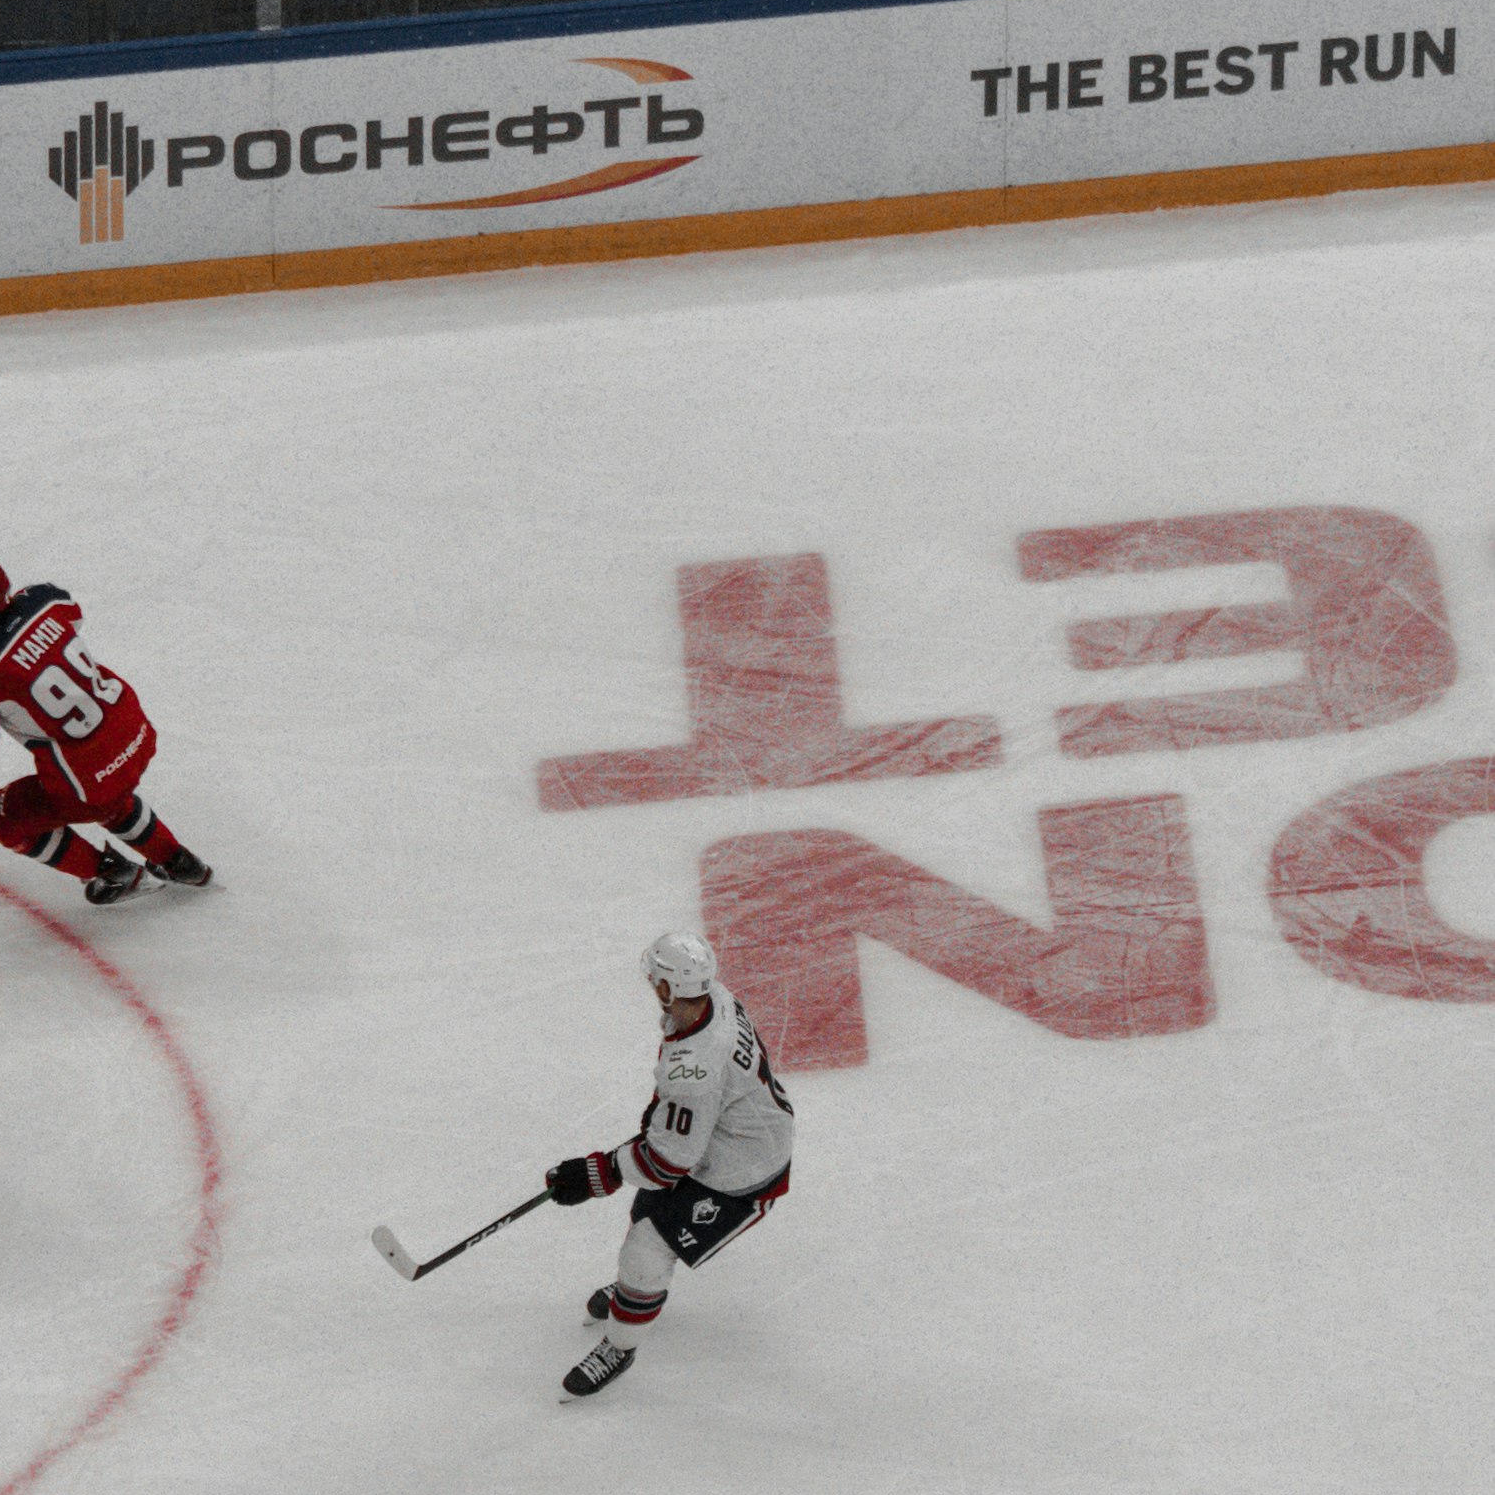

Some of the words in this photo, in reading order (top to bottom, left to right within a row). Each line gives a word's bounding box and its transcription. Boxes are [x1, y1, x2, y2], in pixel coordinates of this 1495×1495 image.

[970, 59, 1104, 117] THE
[1127, 41, 1299, 104] BEST
[1318, 27, 1457, 87] RUN
[167, 95, 704, 187] РОСНЕФТЬ
[11, 617, 66, 672] MAMIN
[665, 1101, 694, 1136] 10
